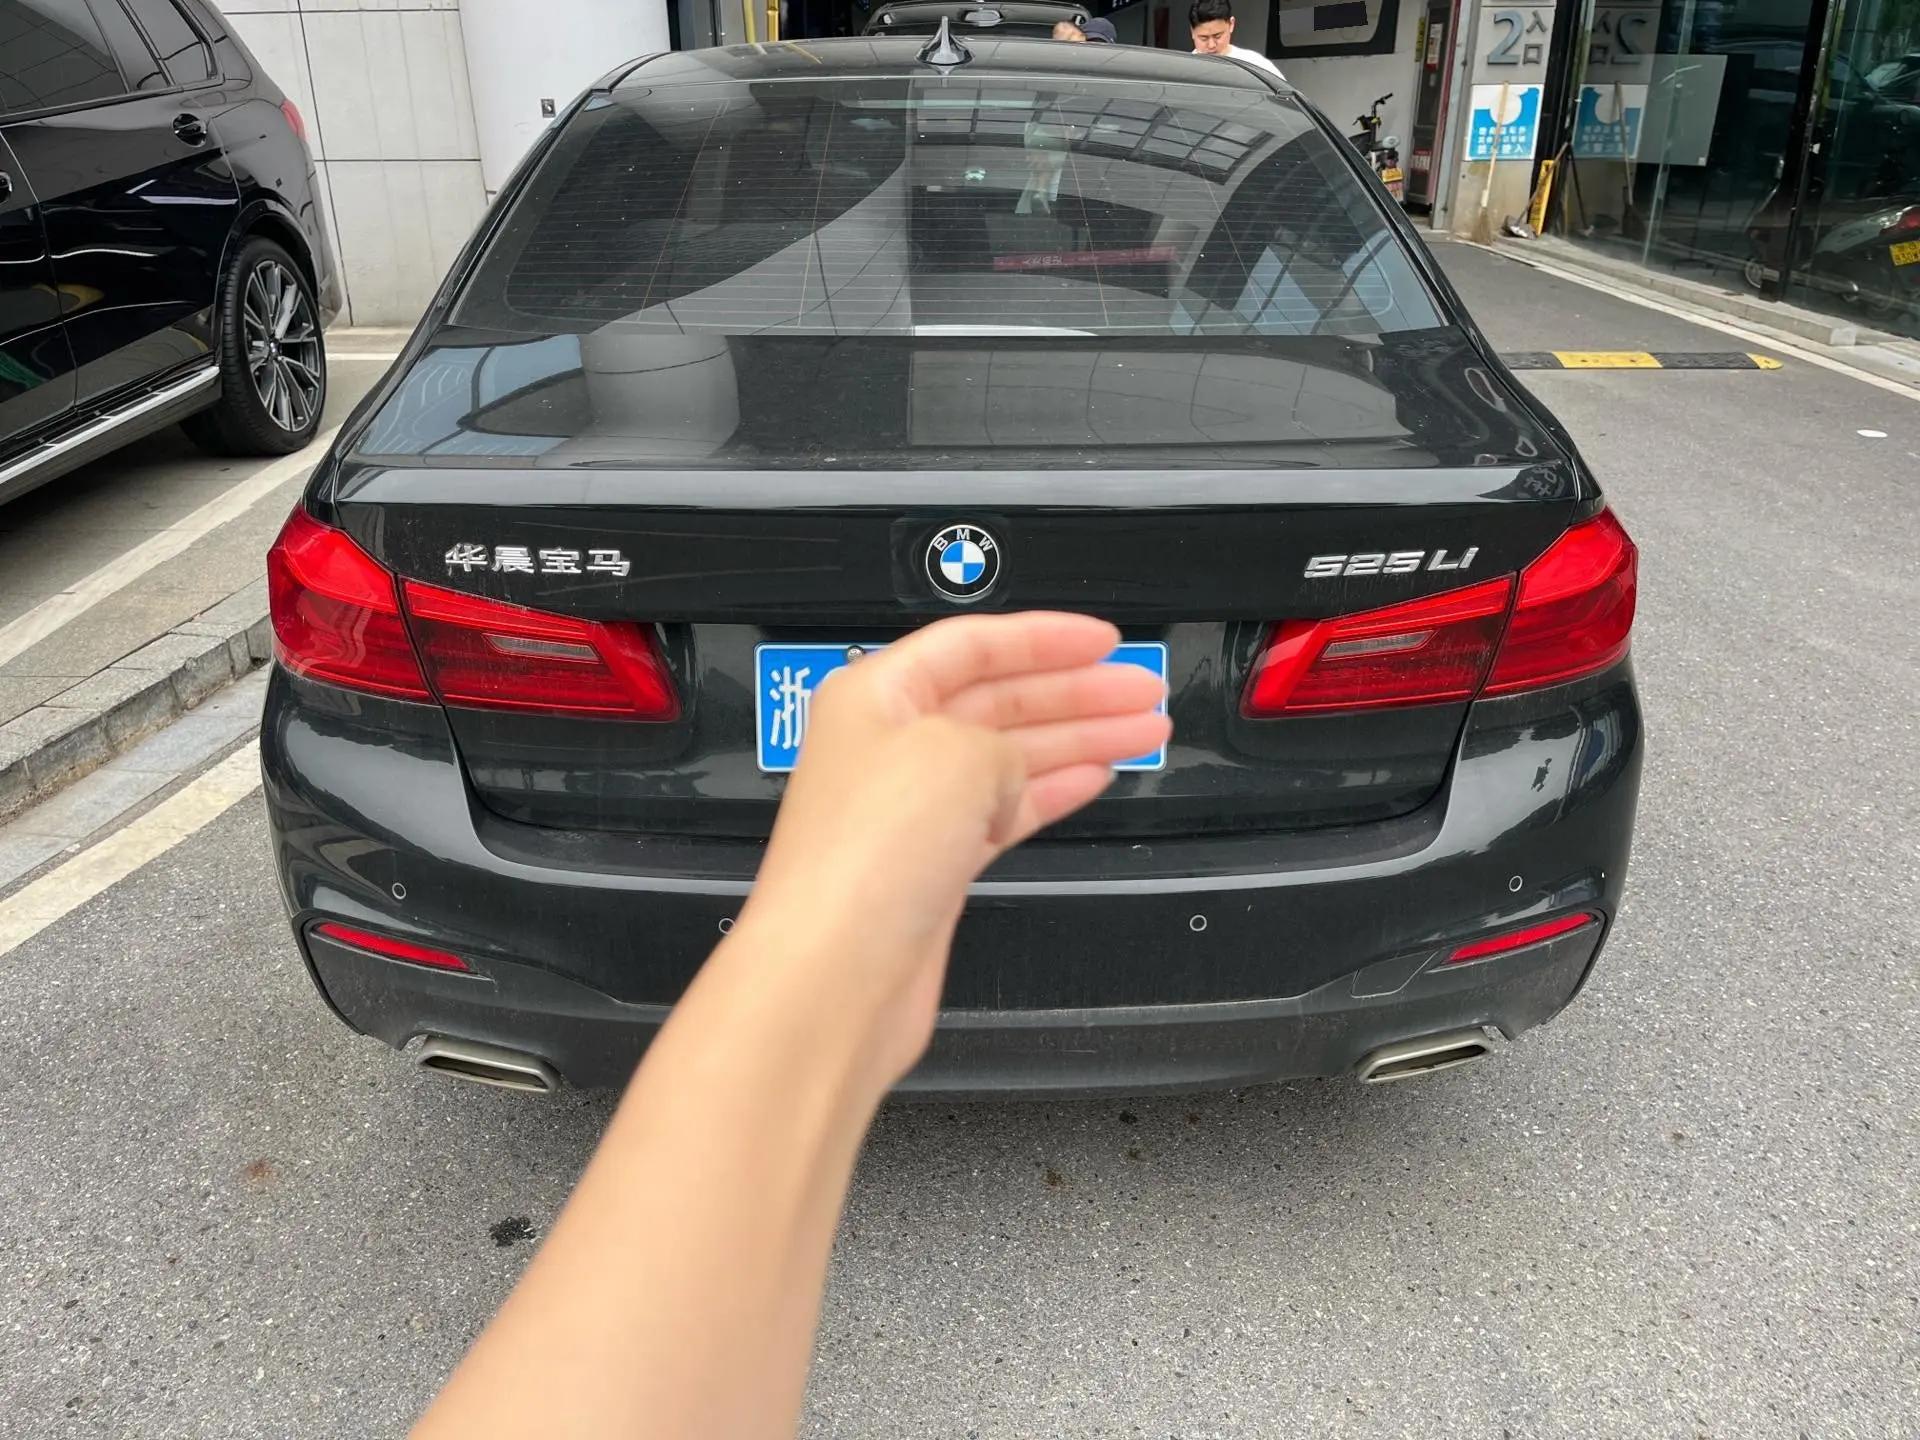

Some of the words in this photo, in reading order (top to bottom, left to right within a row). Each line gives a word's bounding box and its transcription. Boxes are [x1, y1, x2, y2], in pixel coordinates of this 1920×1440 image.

[1487, 11, 1523, 65] 2
[1522, 9, 1547, 65] 入口
[445, 543, 631, 577] 华晨宝马
[933, 528, 993, 552] BMW
